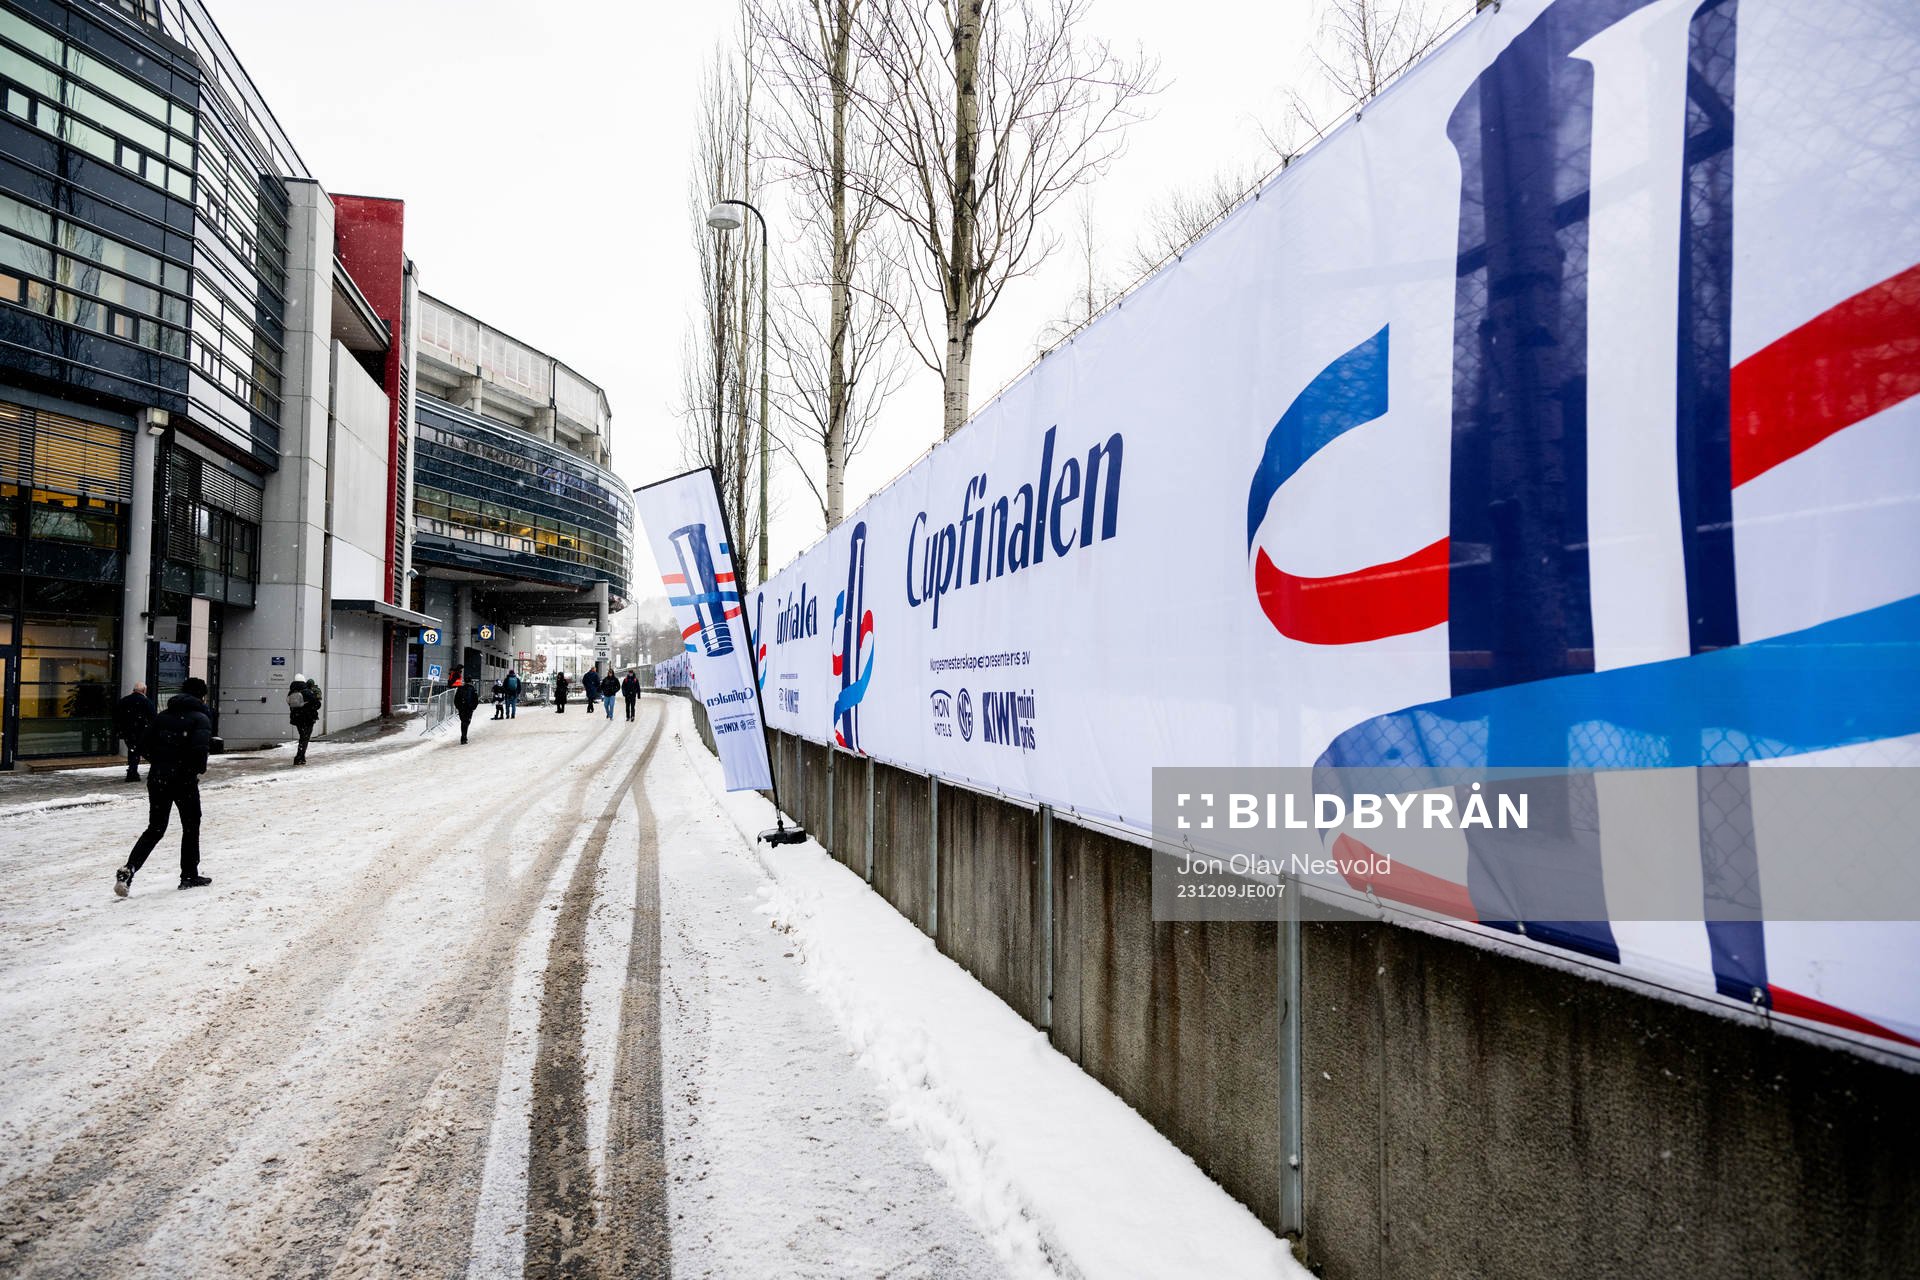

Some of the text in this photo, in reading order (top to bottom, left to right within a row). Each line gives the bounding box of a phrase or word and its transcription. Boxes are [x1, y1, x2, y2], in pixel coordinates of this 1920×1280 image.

[907, 424, 1124, 629] Cupfinalen
[425, 633, 436, 643] 18
[482, 630, 490, 638] 17
[1022, 651, 1031, 665] av
[1017, 688, 1035, 719] mini
[934, 722, 952, 738] HOTELS
[982, 691, 1020, 747] KIWI
[1020, 719, 1035, 754] pris
